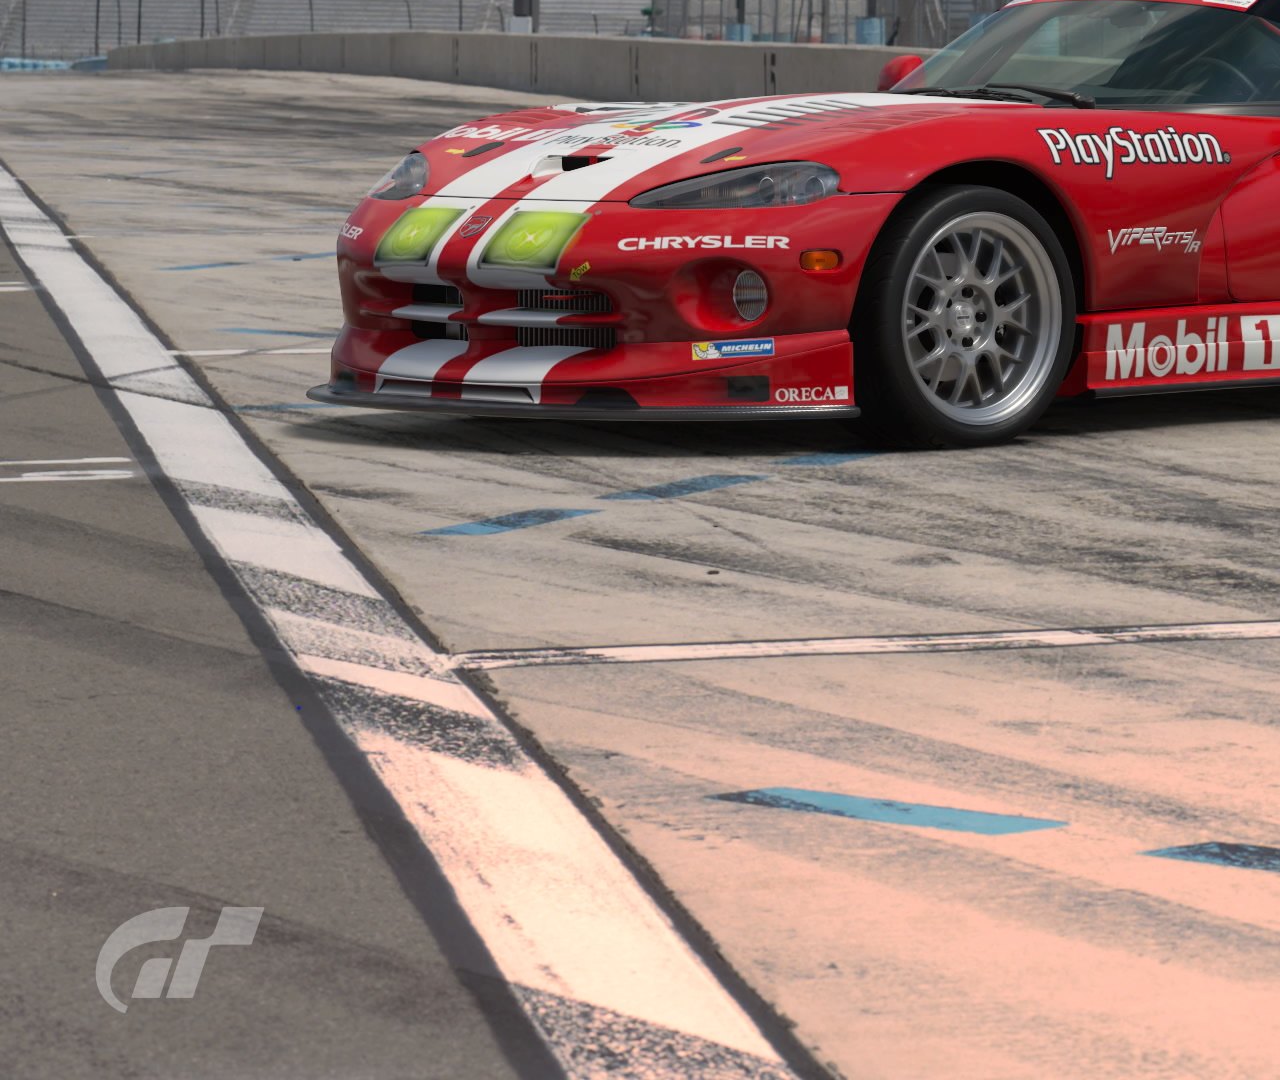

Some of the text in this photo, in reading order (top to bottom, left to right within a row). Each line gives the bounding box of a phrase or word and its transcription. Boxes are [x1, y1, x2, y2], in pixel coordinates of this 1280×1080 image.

[544, 134, 682, 148] PlayStation
[617, 235, 791, 251] CHRYSLER
[722, 343, 772, 352] MICHELIN
[1105, 316, 1229, 380] Mobil
[775, 386, 836, 402] ORECA
